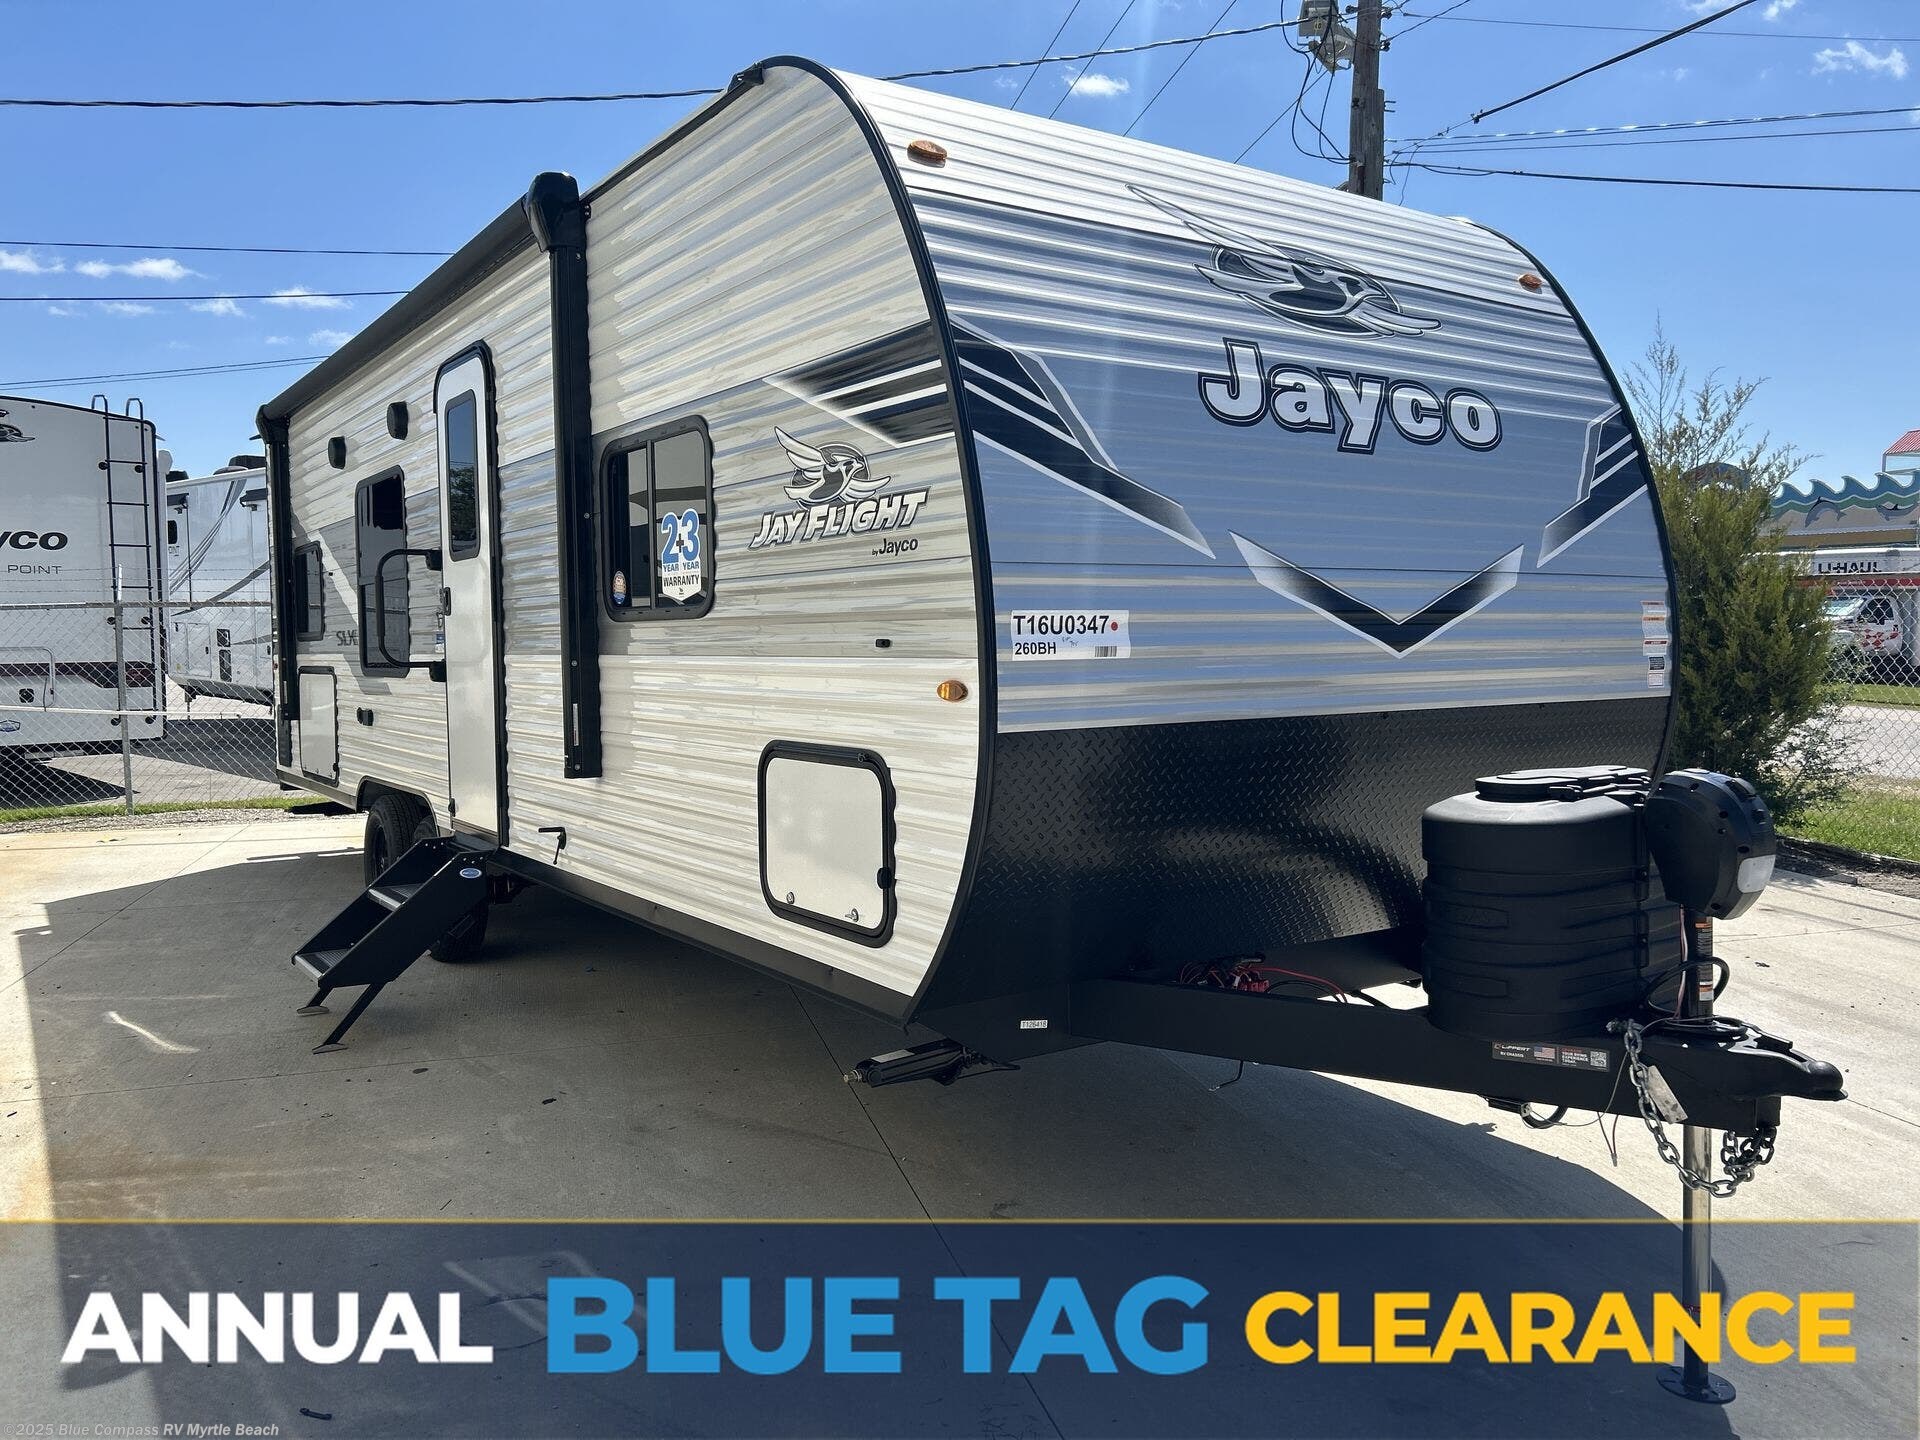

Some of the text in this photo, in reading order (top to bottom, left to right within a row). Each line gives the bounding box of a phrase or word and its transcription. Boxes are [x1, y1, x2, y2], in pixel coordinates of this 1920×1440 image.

[1198, 337, 1503, 455] Jayco
[879, 538, 919, 556] Jayco
[8, 564, 62, 574] POINT
[663, 561, 699, 572] YEAR YEAR
[1818, 561, 1882, 574] U-HAUL
[663, 574, 700, 587] WARRANTY
[1013, 615, 1109, 635] T16U0347
[1015, 642, 1057, 655] 260BH
